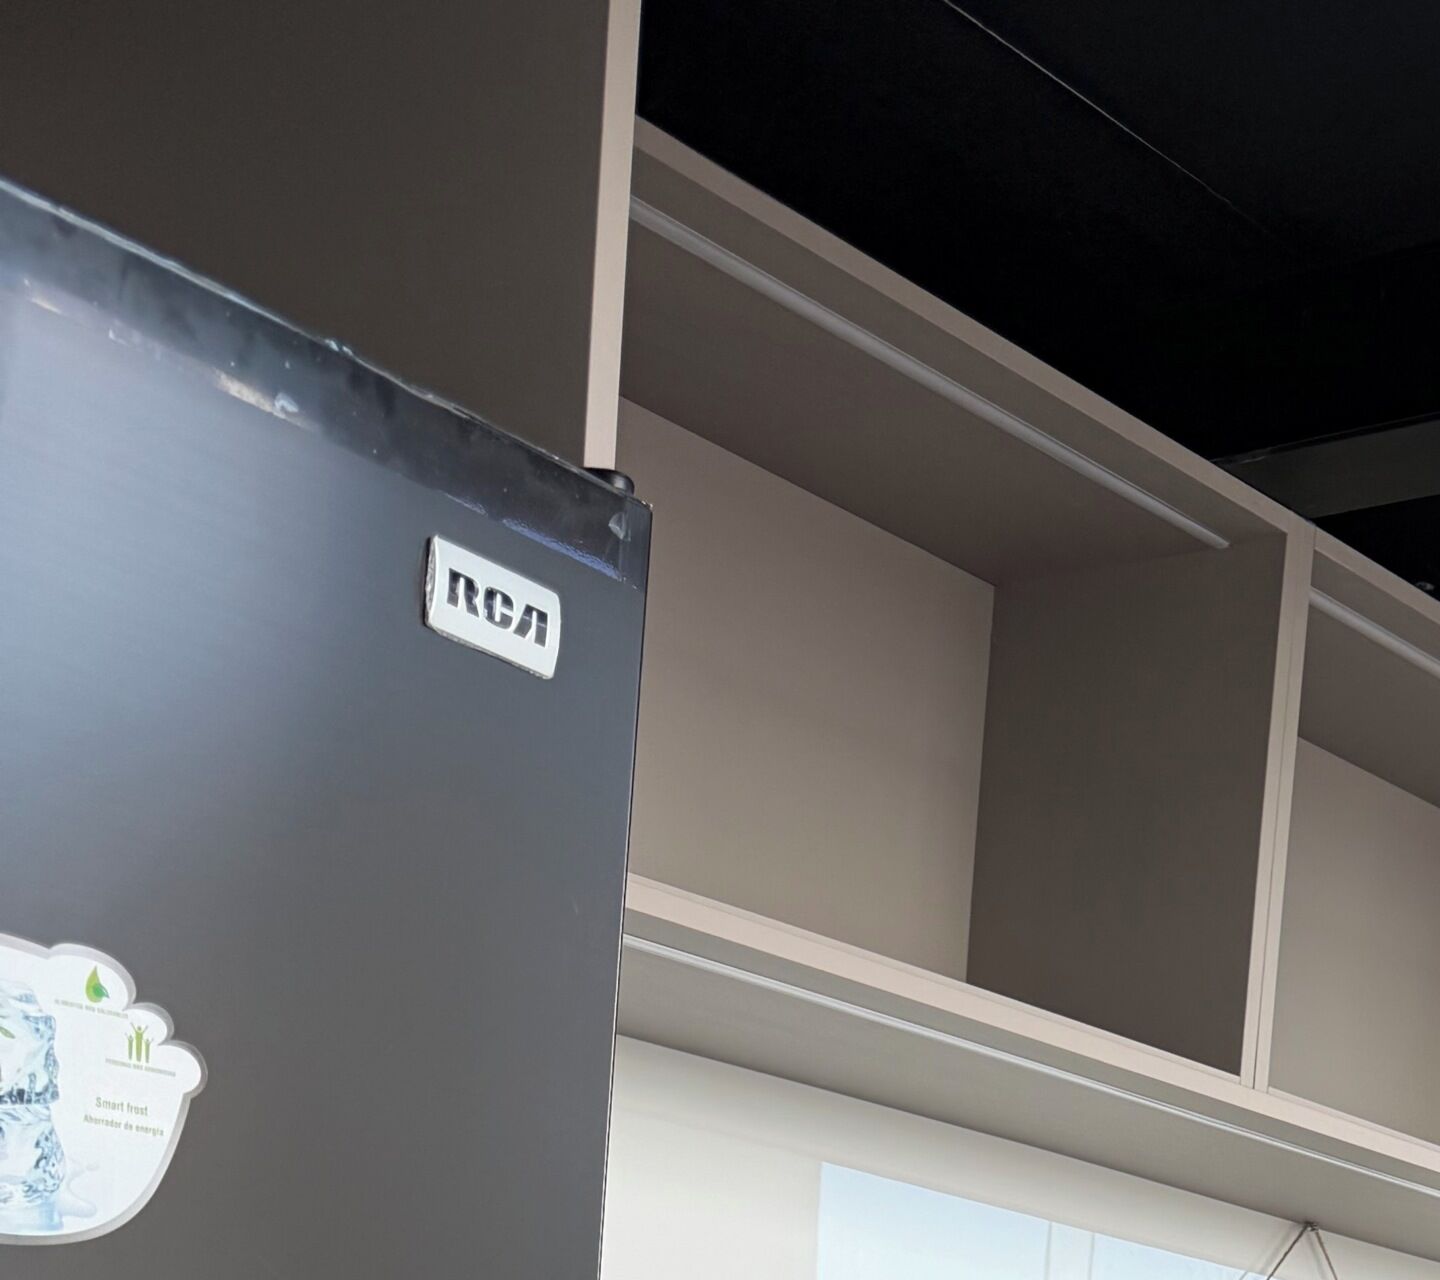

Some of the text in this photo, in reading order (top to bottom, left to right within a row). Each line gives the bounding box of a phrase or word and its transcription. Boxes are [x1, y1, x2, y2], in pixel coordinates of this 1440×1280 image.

[447, 567, 548, 648] RCA
[95, 1096, 148, 1117] Smart frost
